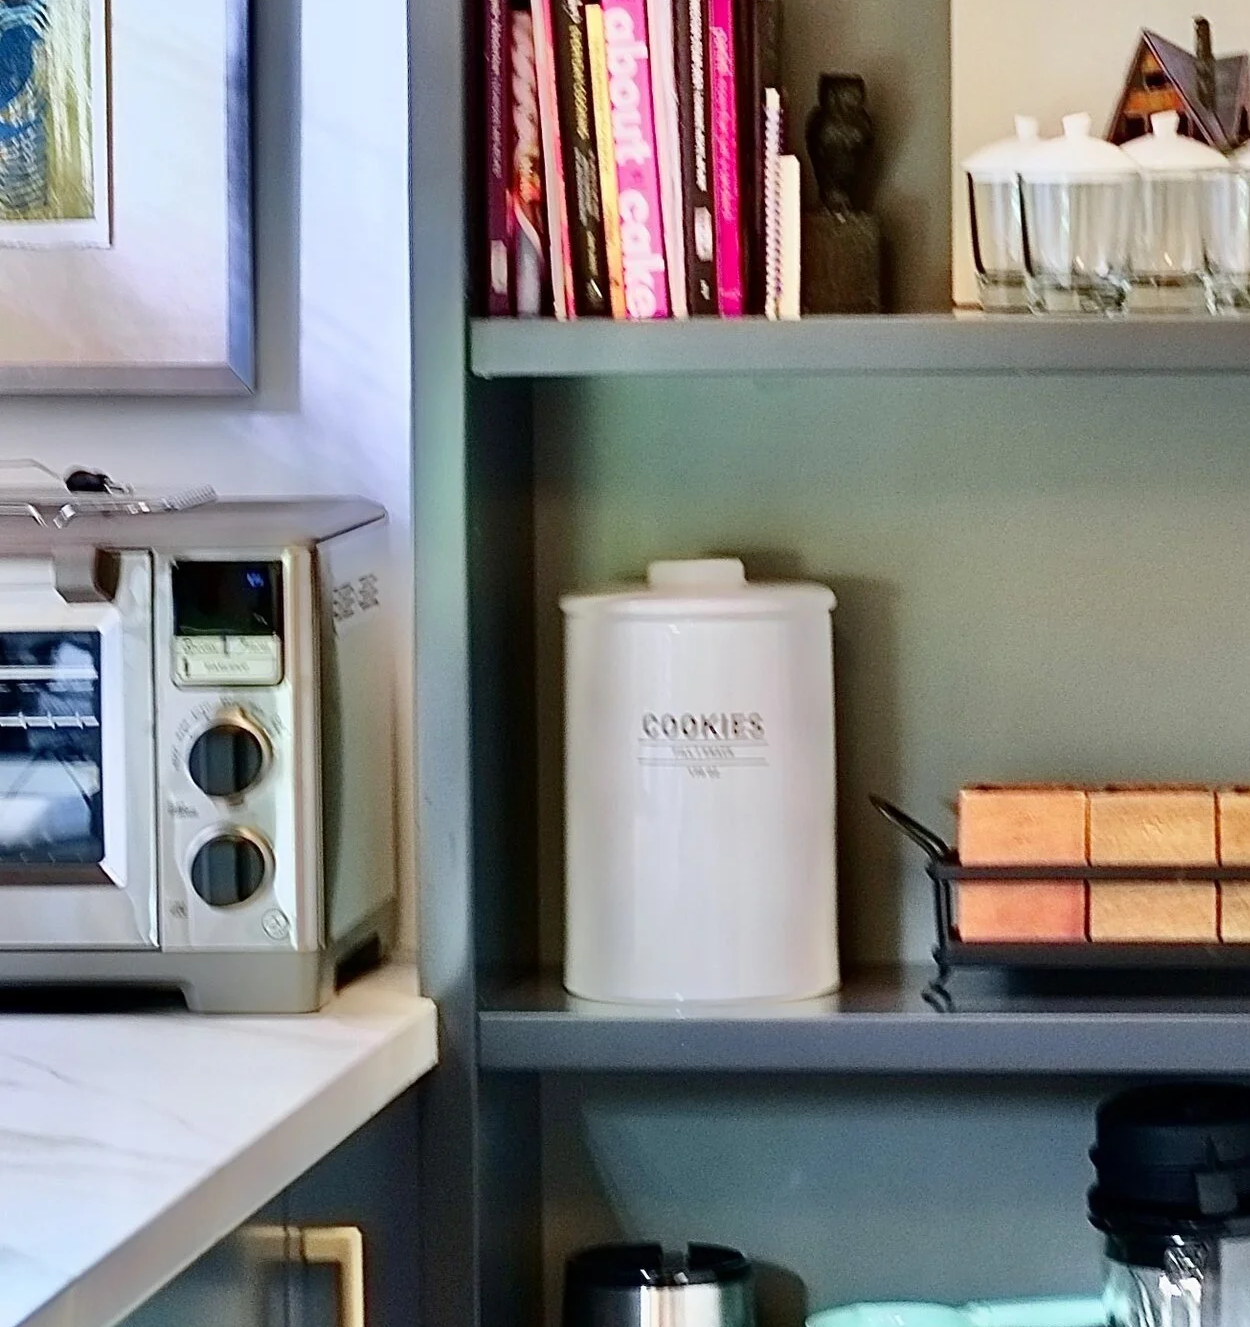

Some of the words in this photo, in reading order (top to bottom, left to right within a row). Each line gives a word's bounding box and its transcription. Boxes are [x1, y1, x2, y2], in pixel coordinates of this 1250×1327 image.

[605, 6, 650, 166] about
[618, 188, 666, 319] cake
[642, 711, 766, 740] COOKIES
